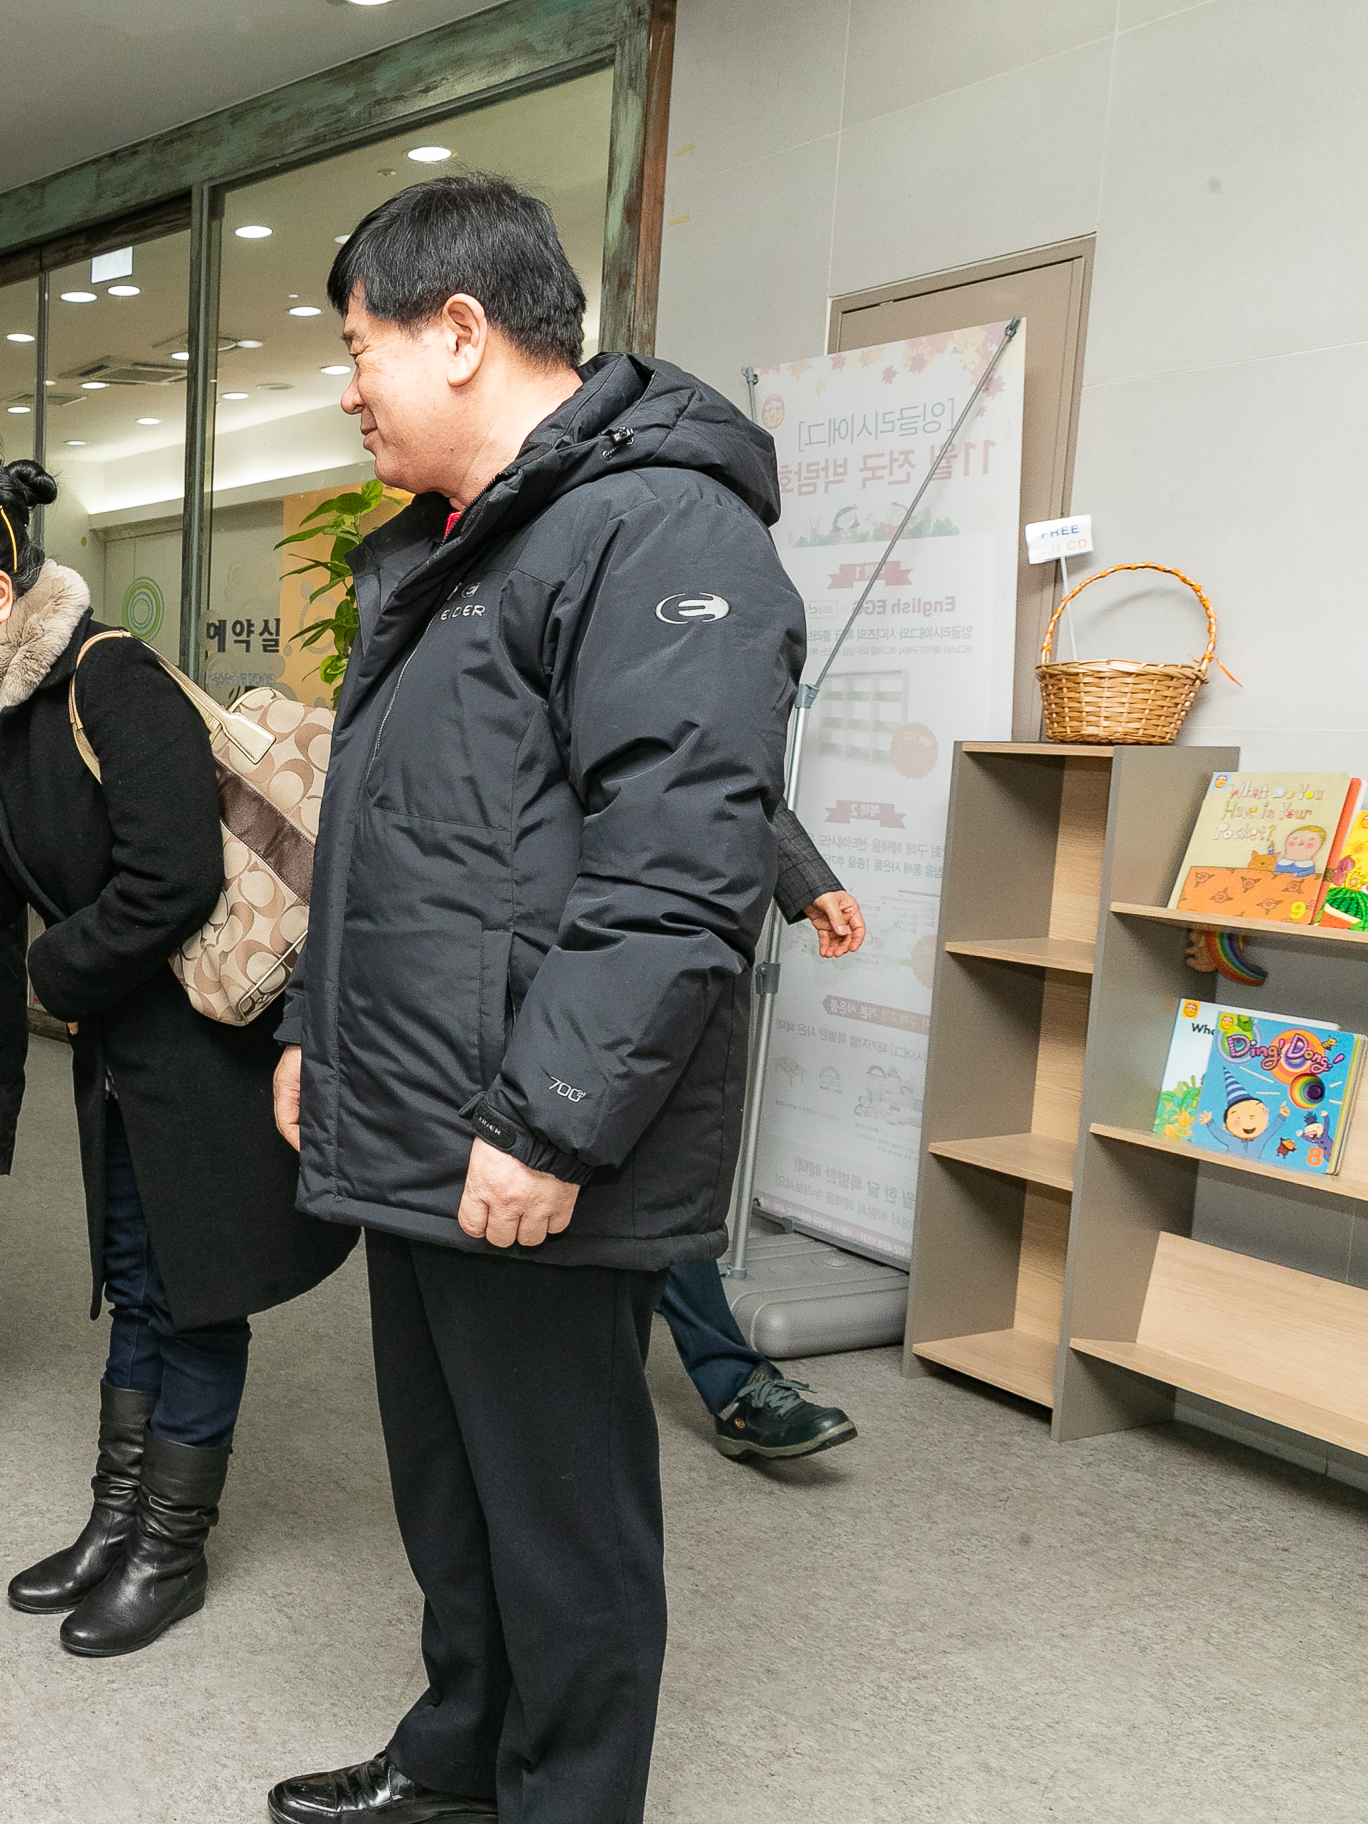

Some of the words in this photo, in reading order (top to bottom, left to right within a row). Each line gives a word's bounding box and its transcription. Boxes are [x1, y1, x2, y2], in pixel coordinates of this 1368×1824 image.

[1066, 538, 1088, 551] CD
[440, 604, 486, 621] EIDER
[206, 617, 281, 653] 예약실
[1229, 780, 1271, 800] What
[1297, 783, 1326, 801] You
[1220, 801, 1259, 821] Have
[1260, 801, 1276, 820] in
[1278, 801, 1313, 821] Your
[1214, 821, 1277, 843] Pocket?
[1289, 901, 1307, 920] 9
[1226, 1033, 1286, 1071] Ding!
[1285, 1033, 1345, 1075] Dong!
[1306, 1147, 1324, 1167] 8
